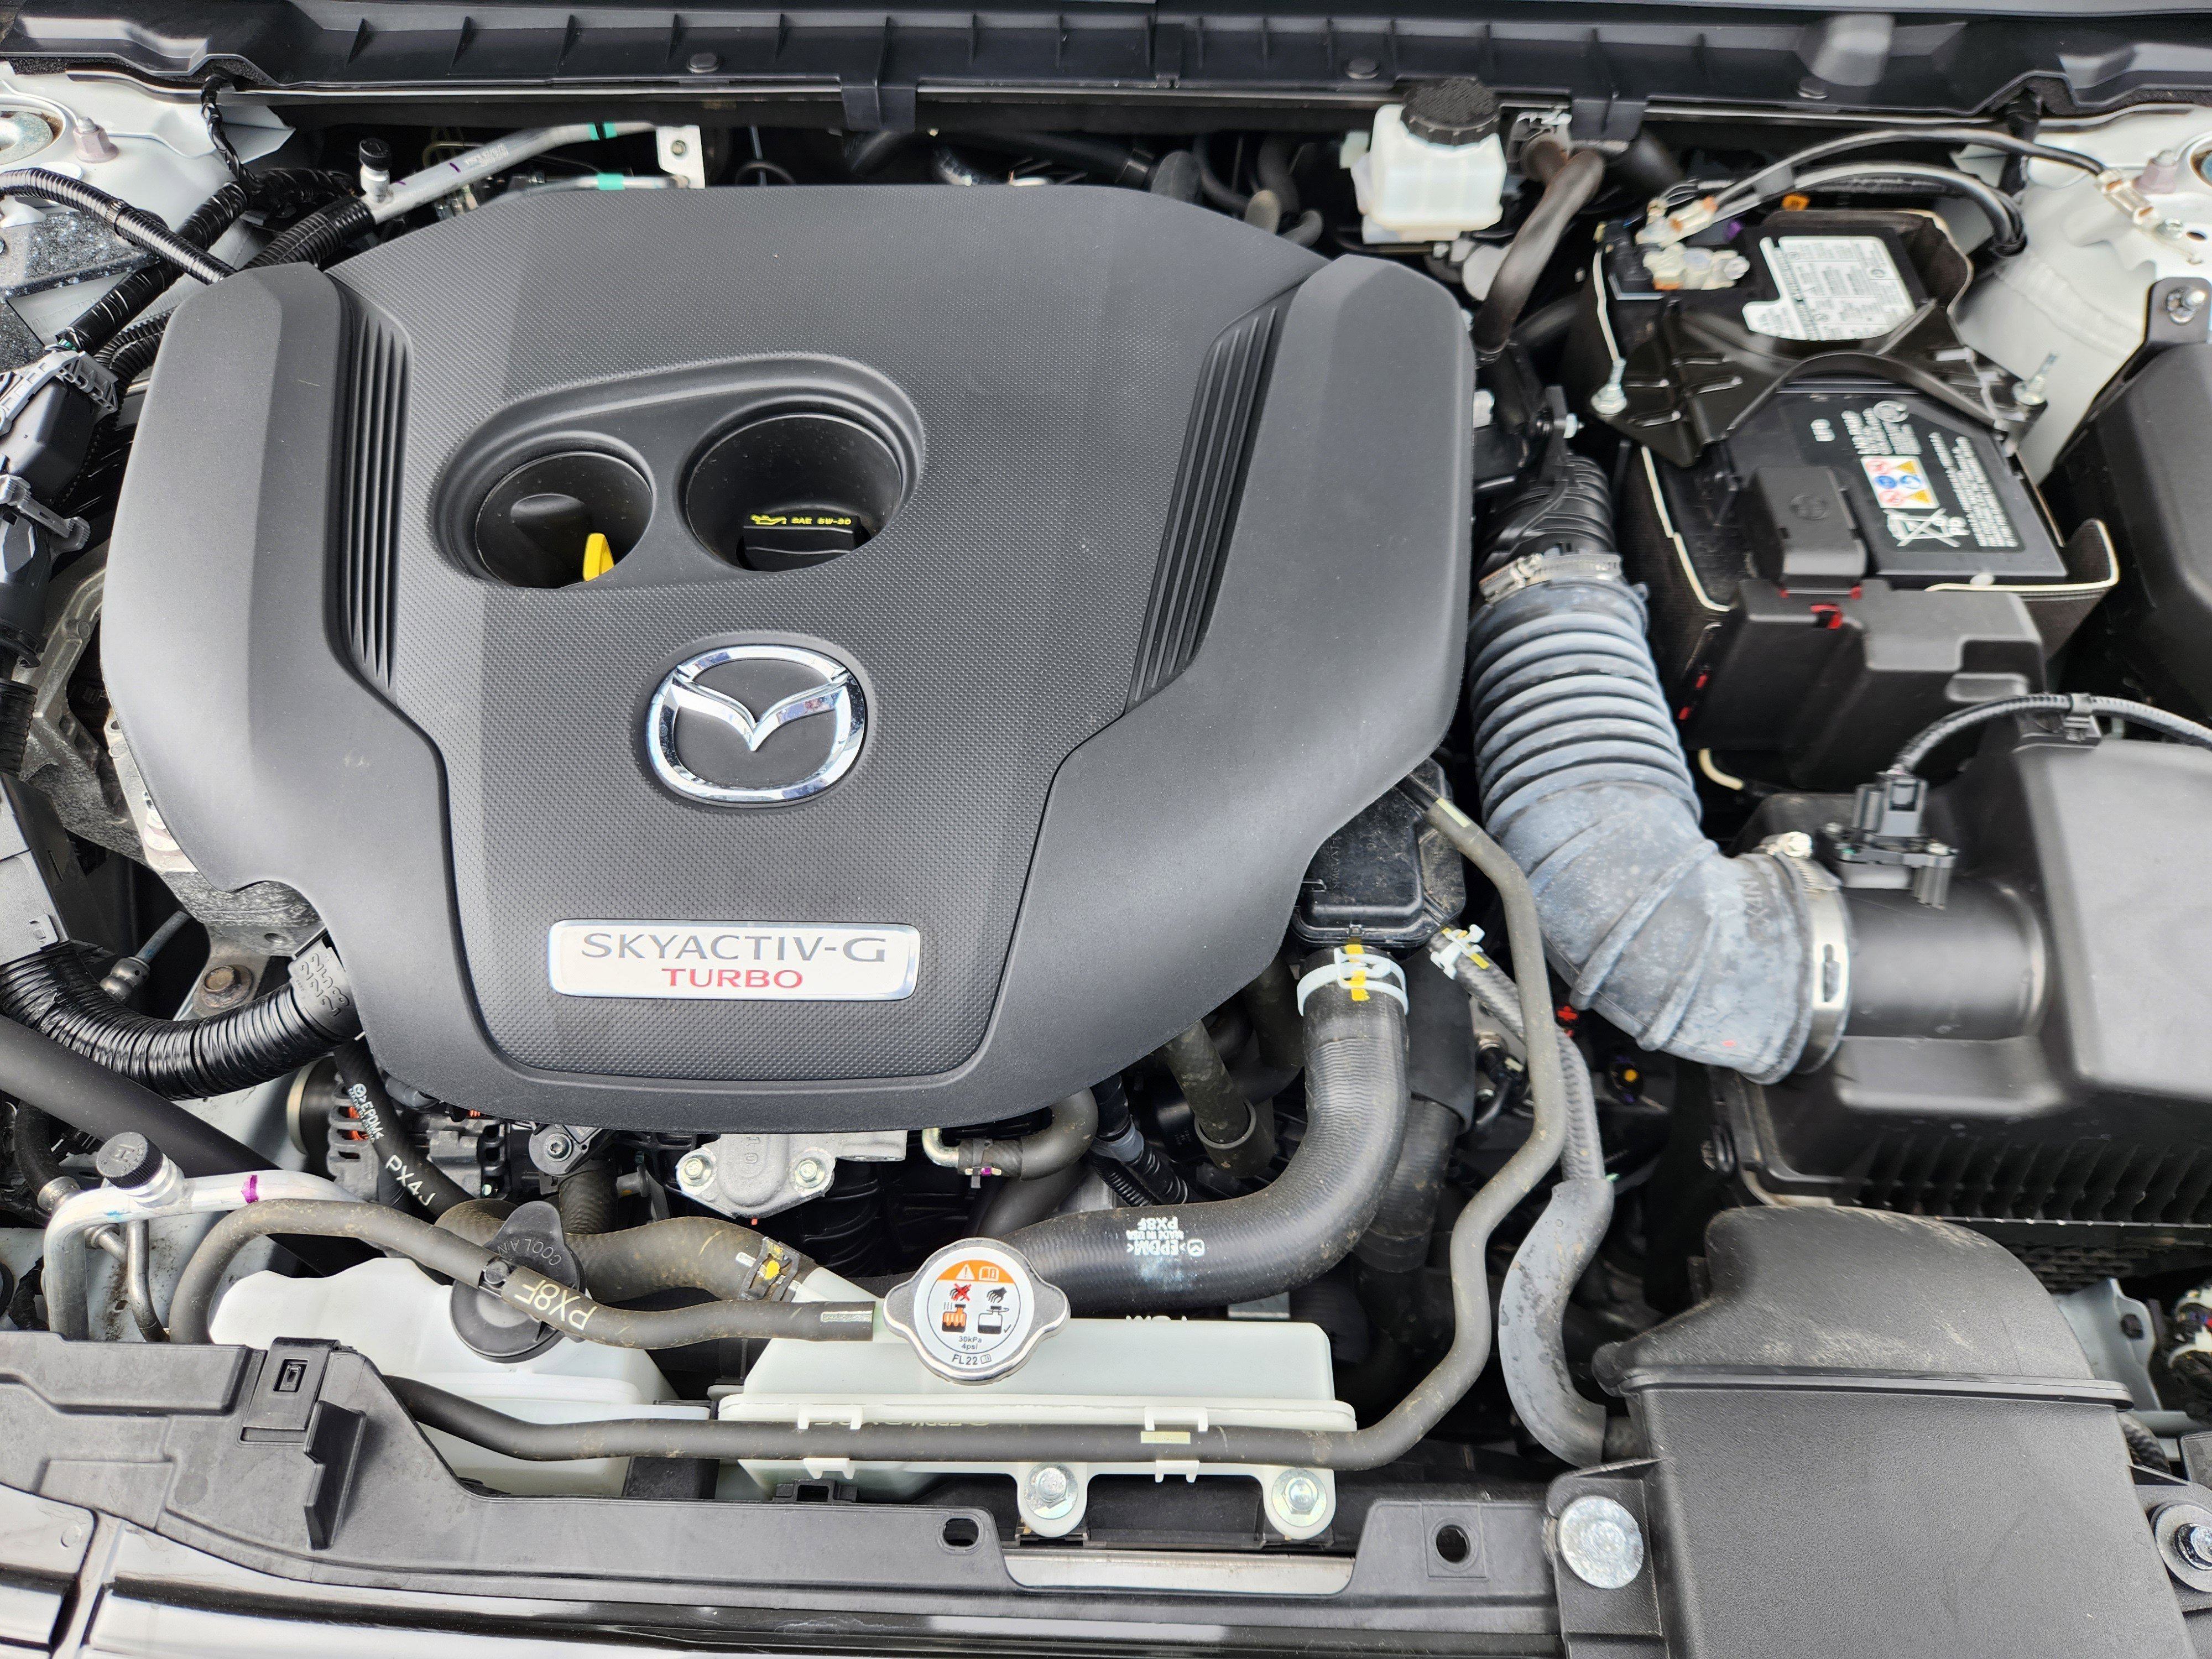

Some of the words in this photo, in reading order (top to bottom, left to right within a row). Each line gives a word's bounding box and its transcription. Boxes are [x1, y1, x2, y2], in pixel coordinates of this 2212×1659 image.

[817, 517, 852, 525] 5W-30
[582, 932, 886, 963] SKYACTIV-G
[661, 968, 804, 989] TURBO
[385, 1154, 436, 1206] PX4J
[1138, 1216, 1179, 1231] PX8F
[498, 1238, 562, 1265] COOLAN
[514, 1280, 597, 1331] PX8F
[951, 1353, 978, 1365] FL22
